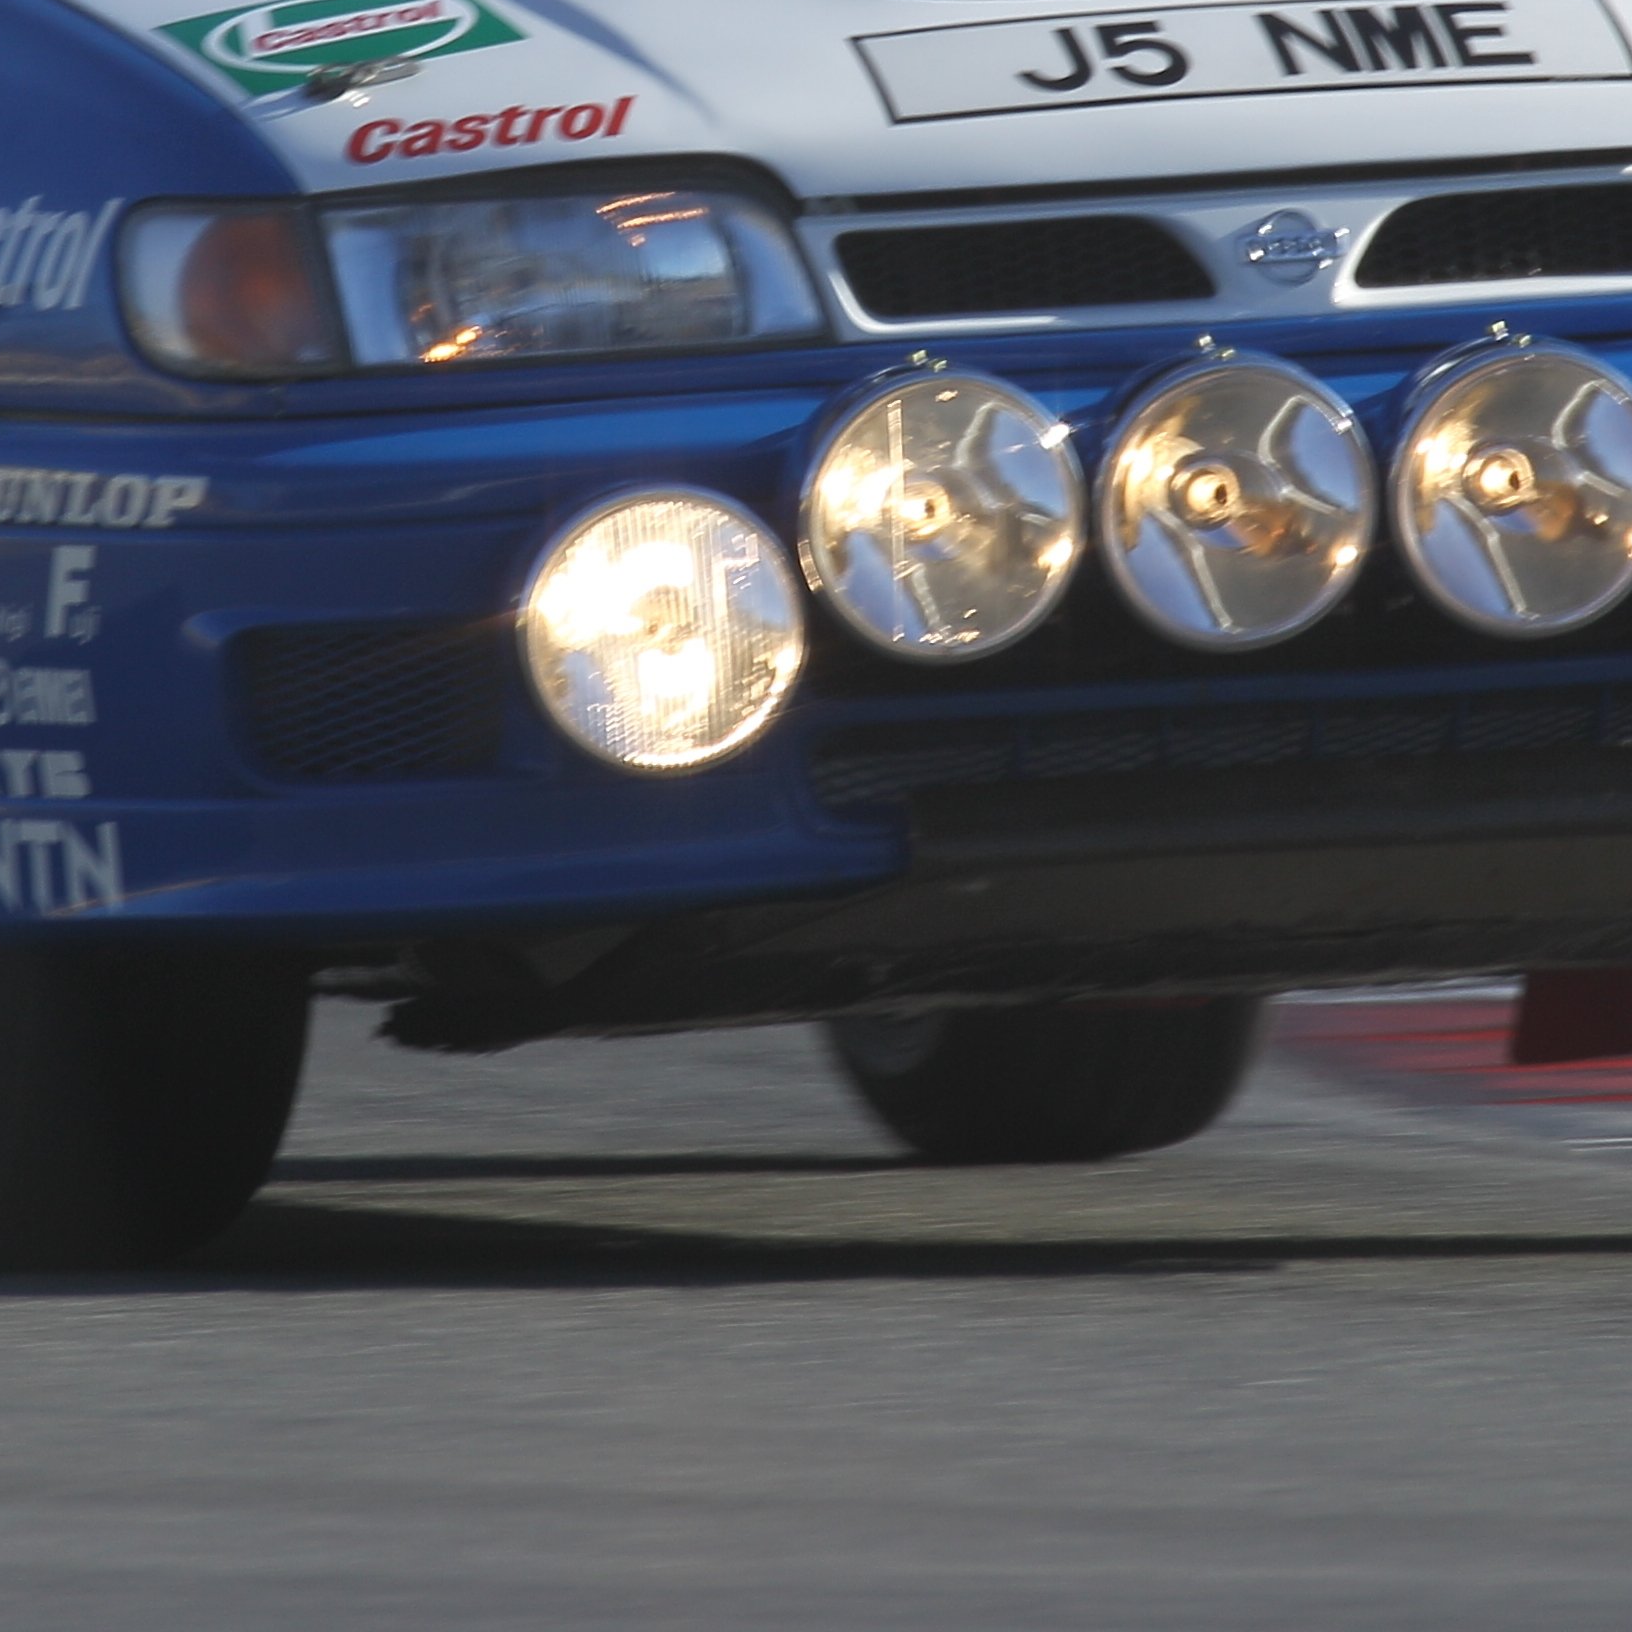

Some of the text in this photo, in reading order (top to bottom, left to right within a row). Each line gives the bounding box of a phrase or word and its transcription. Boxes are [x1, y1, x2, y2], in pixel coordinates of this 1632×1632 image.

[256, 0, 443, 53] Castrol
[1018, 0, 1536, 91] J5 NME
[343, 95, 637, 165] Castrol
